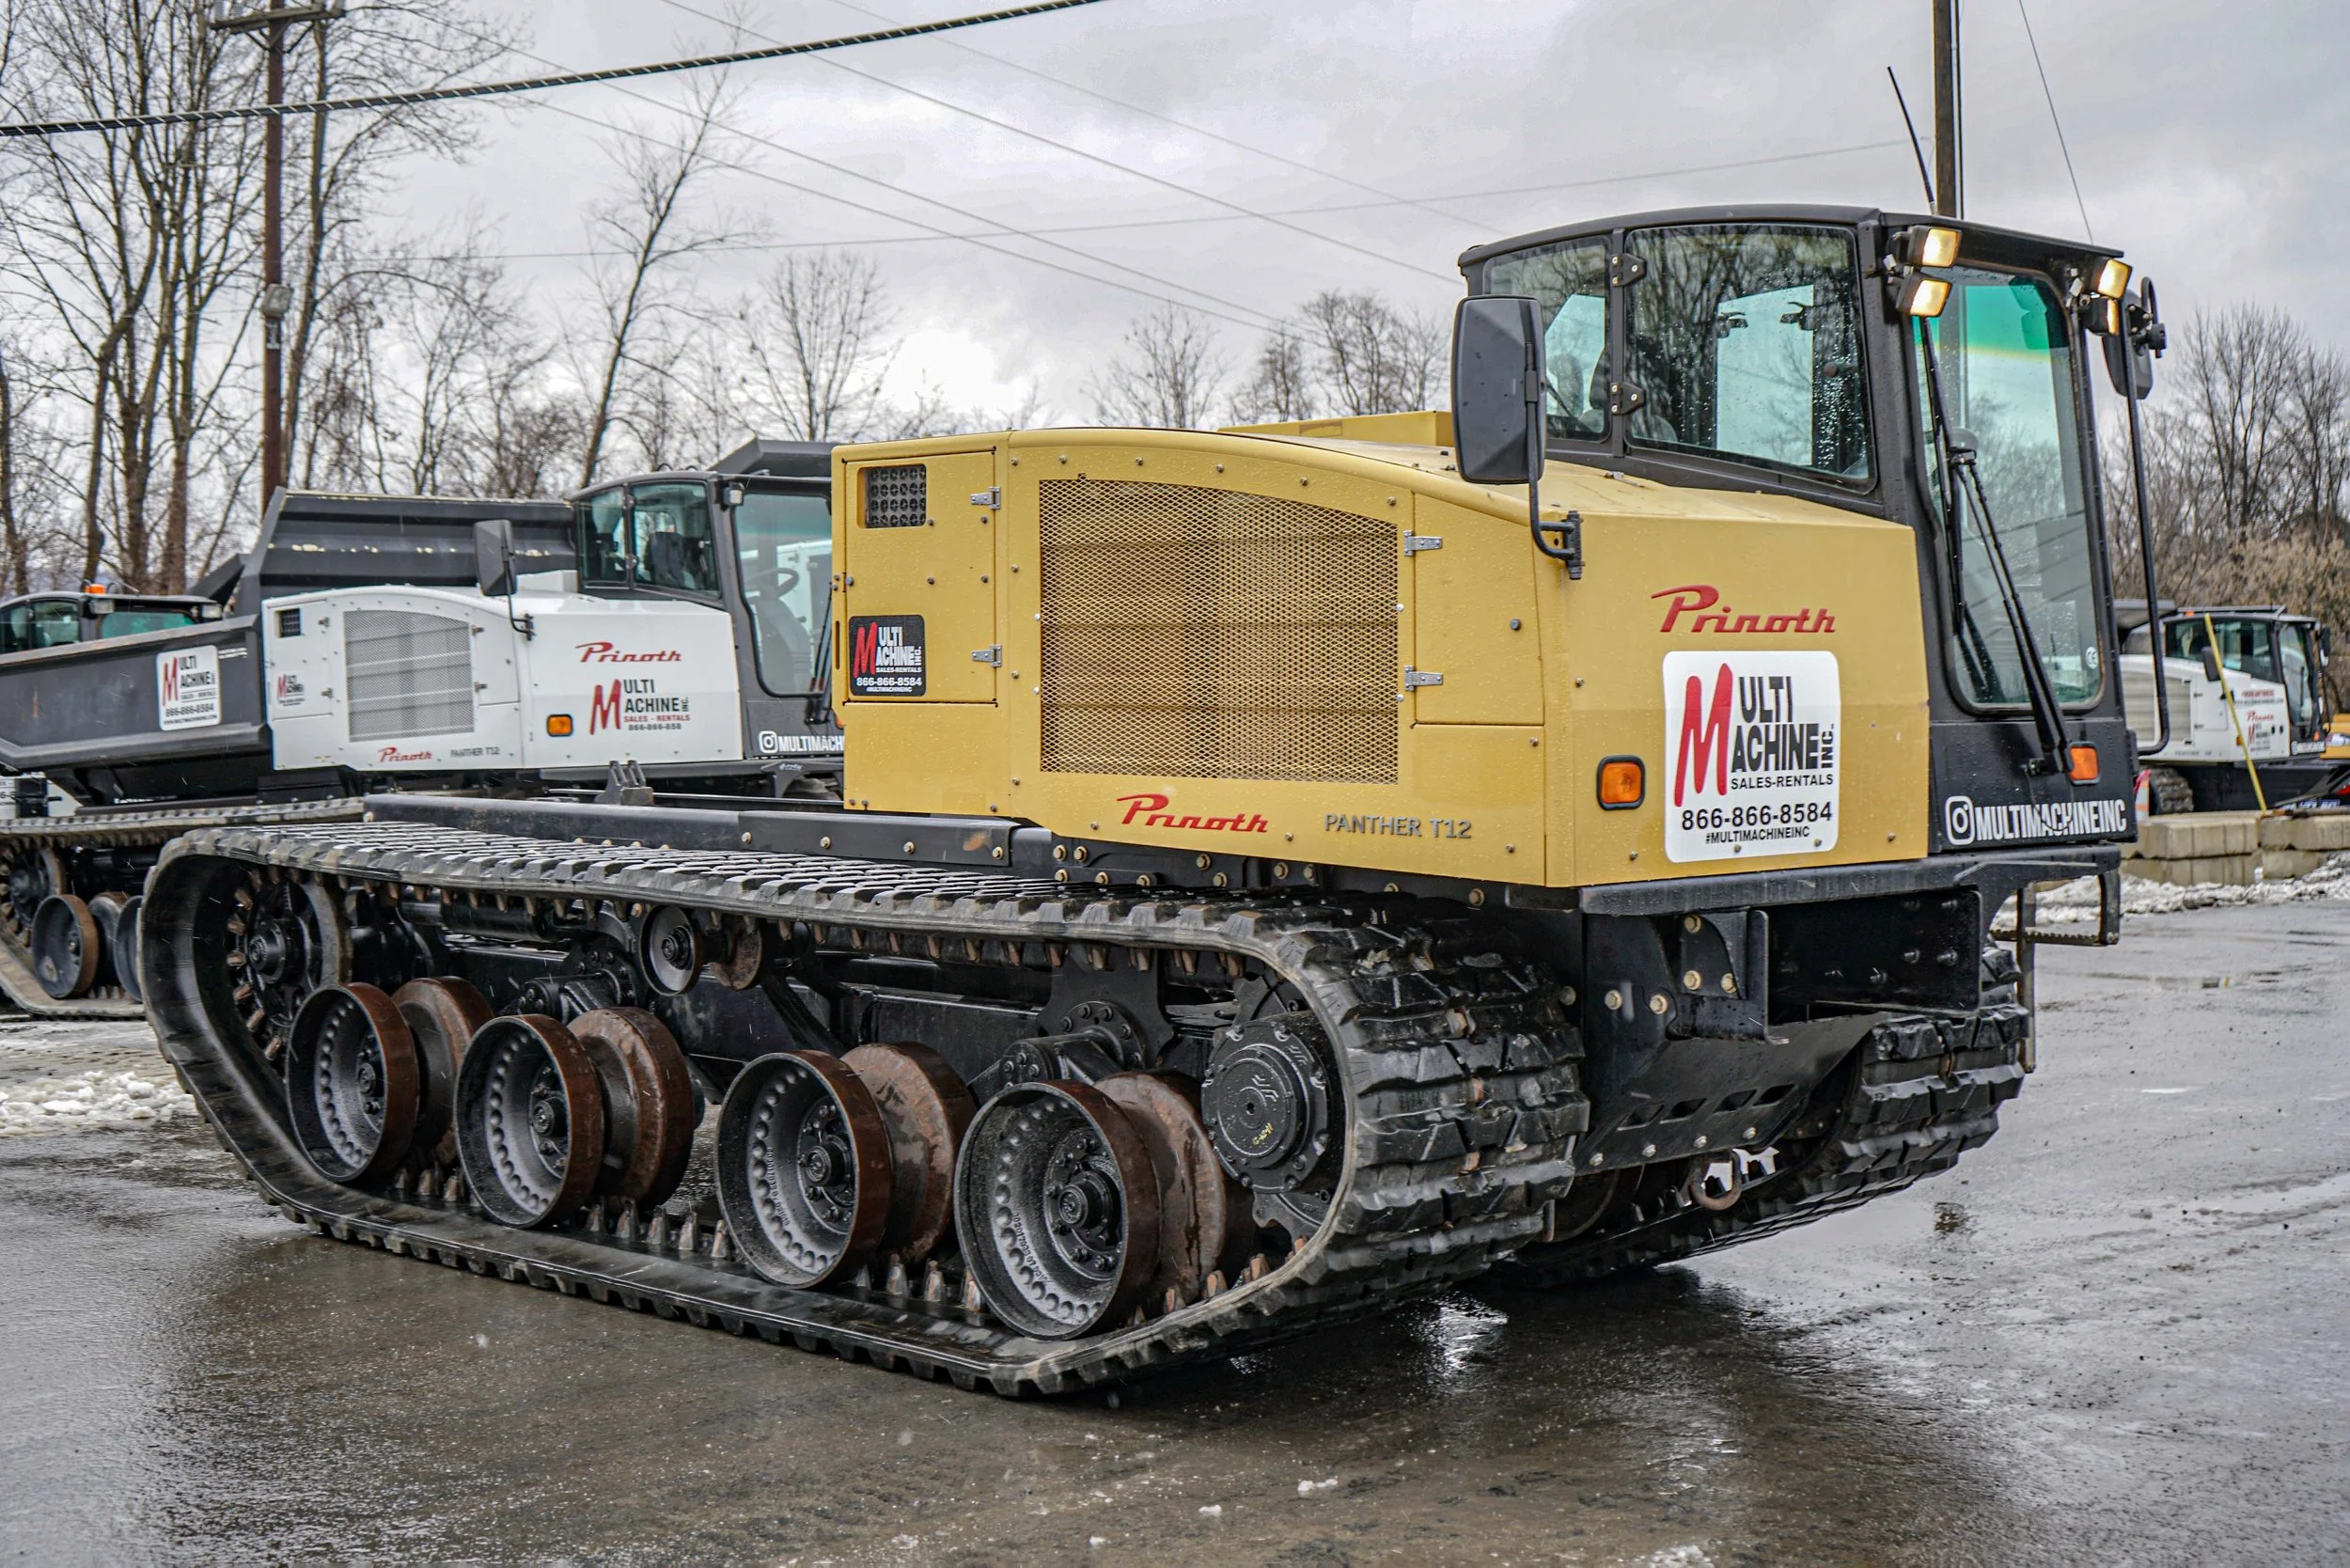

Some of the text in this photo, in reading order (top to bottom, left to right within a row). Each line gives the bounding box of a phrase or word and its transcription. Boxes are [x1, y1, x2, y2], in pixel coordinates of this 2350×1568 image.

[1651, 584, 1836, 633] Prinoth
[574, 641, 682, 663] Prinoth
[855, 677, 922, 686] 866-866-8584
[377, 746, 432, 762] Prinoth
[778, 735, 845, 752] MULTIMACH
[1731, 774, 1834, 790] SALES-RENTALS
[1116, 793, 1268, 833] Prinoth
[1682, 801, 1833, 831] 866-866-8584
[1975, 799, 2127, 841] MULTIMACHINEINC
[1324, 812, 1472, 839] PANTHER T12
[1705, 825, 1810, 845] #MULTIMACHINEINC
